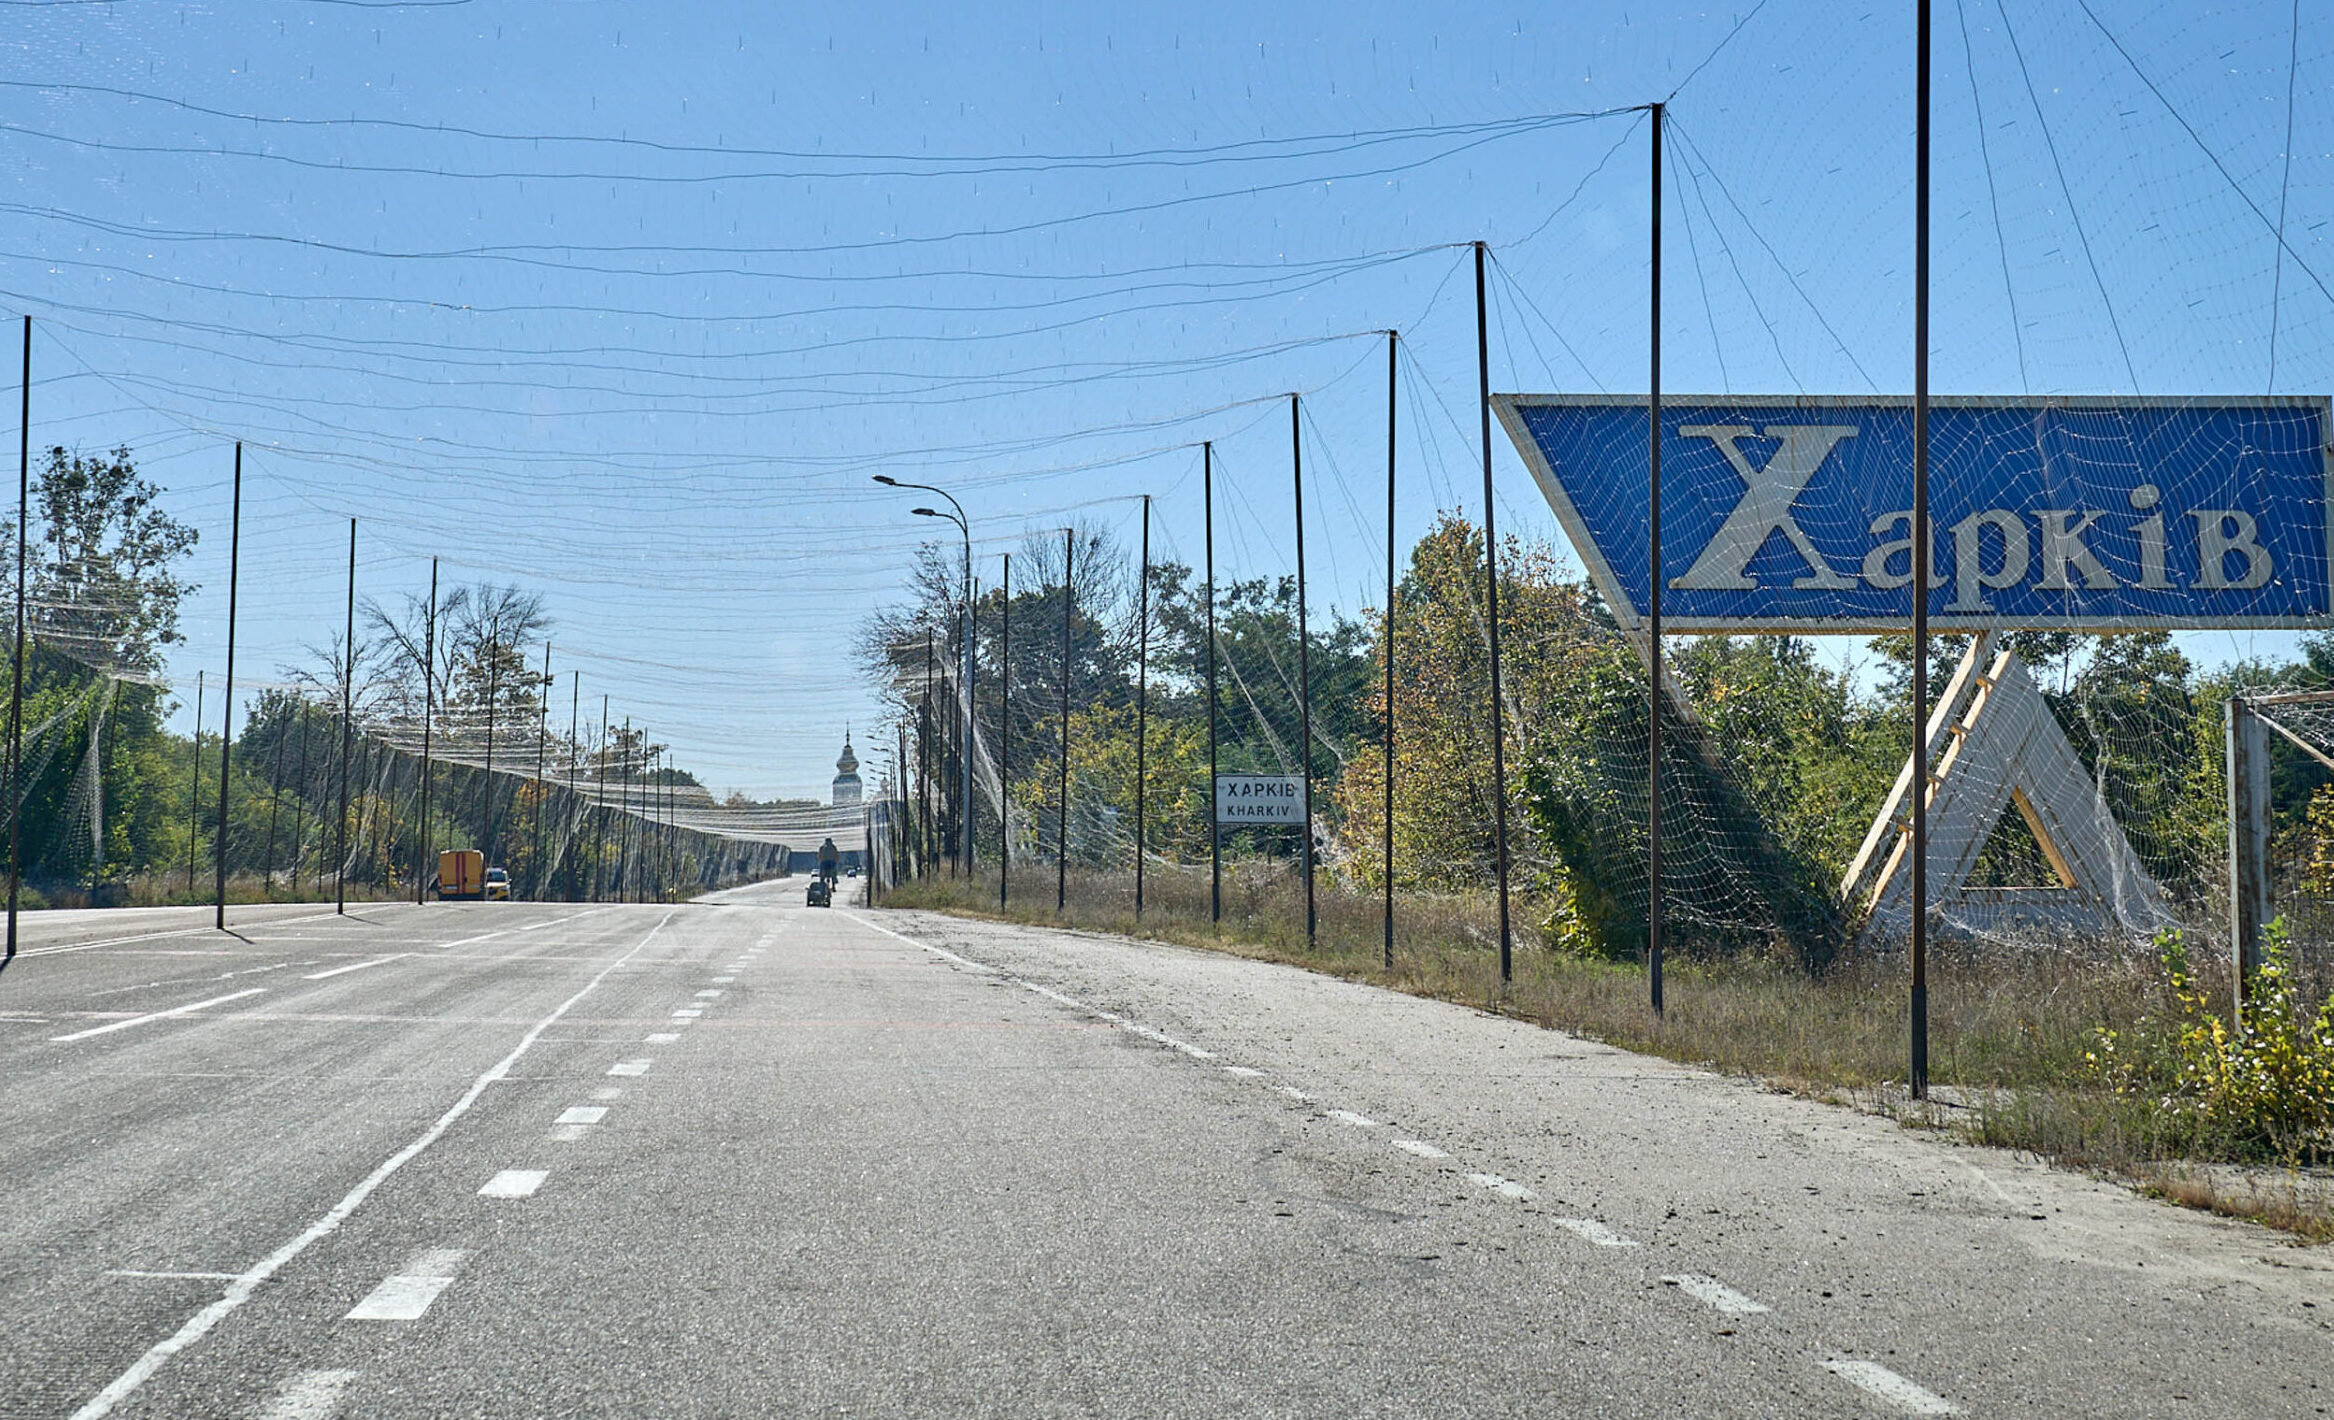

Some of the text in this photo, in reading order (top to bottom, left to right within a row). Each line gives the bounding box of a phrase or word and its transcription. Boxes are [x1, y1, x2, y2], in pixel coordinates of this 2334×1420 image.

[1669, 425, 2273, 611] Харків
[1228, 783, 1295, 797] ХАРКІВ
[1227, 805, 1289, 817] KHARKIV
